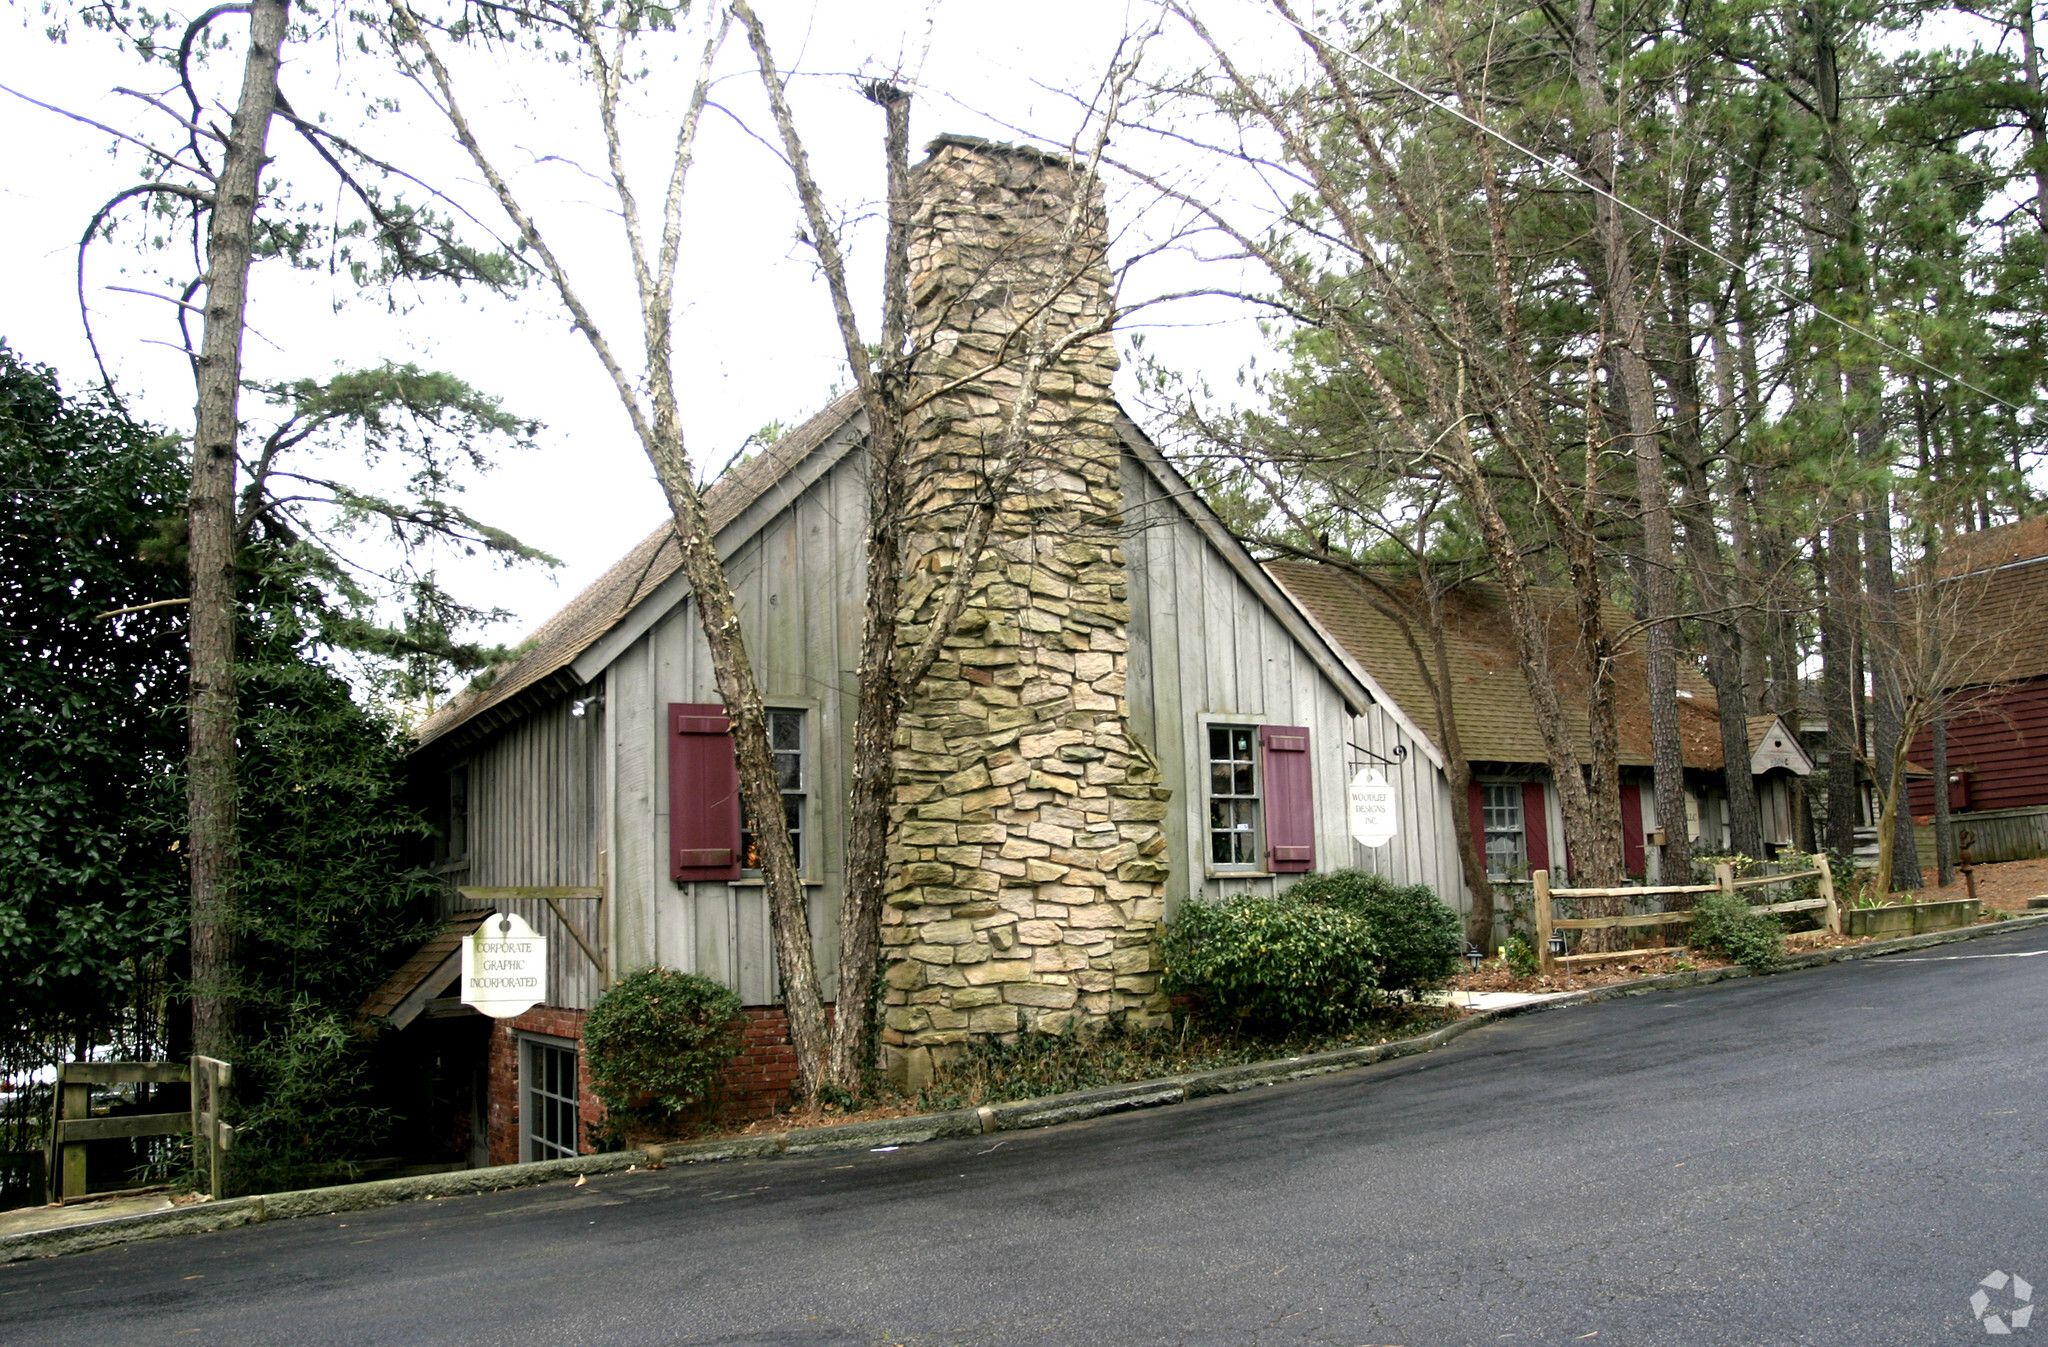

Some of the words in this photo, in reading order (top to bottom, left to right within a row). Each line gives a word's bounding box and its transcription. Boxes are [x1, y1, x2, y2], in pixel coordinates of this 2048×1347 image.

[1355, 805, 1386, 813] DESIGNS
[477, 943, 532, 953] CORPORATE
[483, 960, 525, 971] GRAPHIC
[470, 977, 537, 988] INCORPORATED
